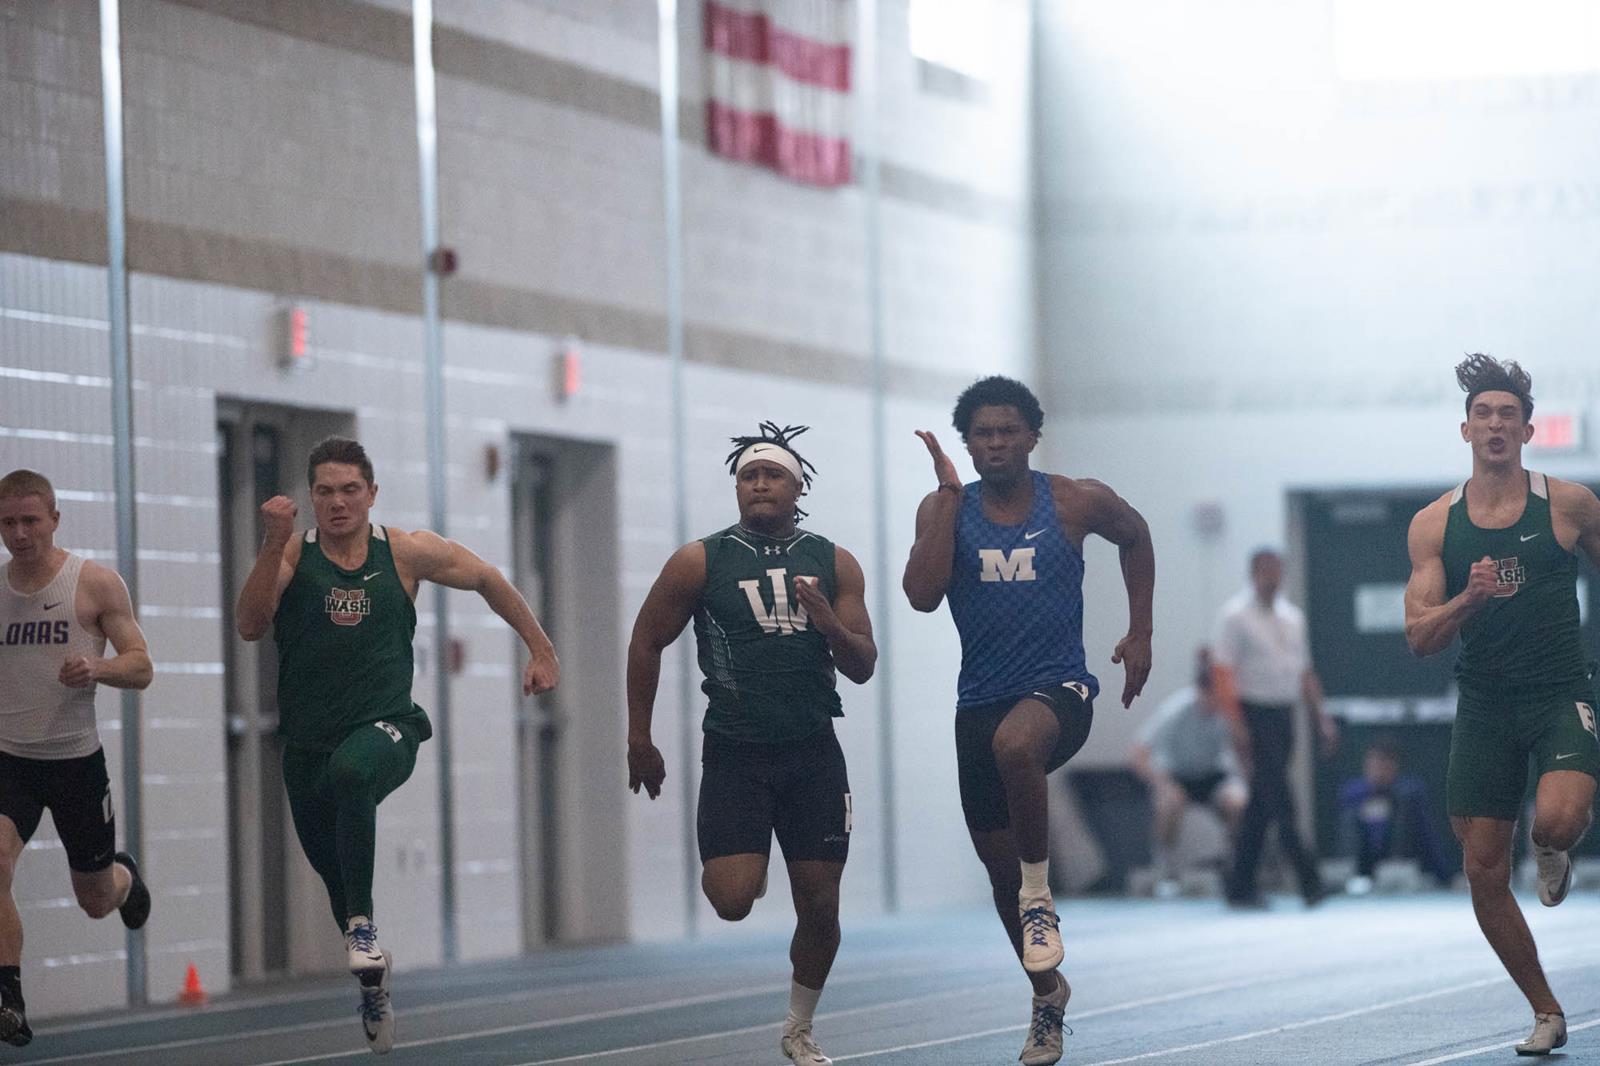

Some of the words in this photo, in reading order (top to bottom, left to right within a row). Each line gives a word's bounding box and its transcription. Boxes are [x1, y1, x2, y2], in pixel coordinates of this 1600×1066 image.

[978, 547, 1037, 582] M
[1495, 567, 1525, 584] ASH
[325, 595, 371, 615] WASH
[738, 567, 819, 636] W
[0, 620, 69, 646] ORAS
